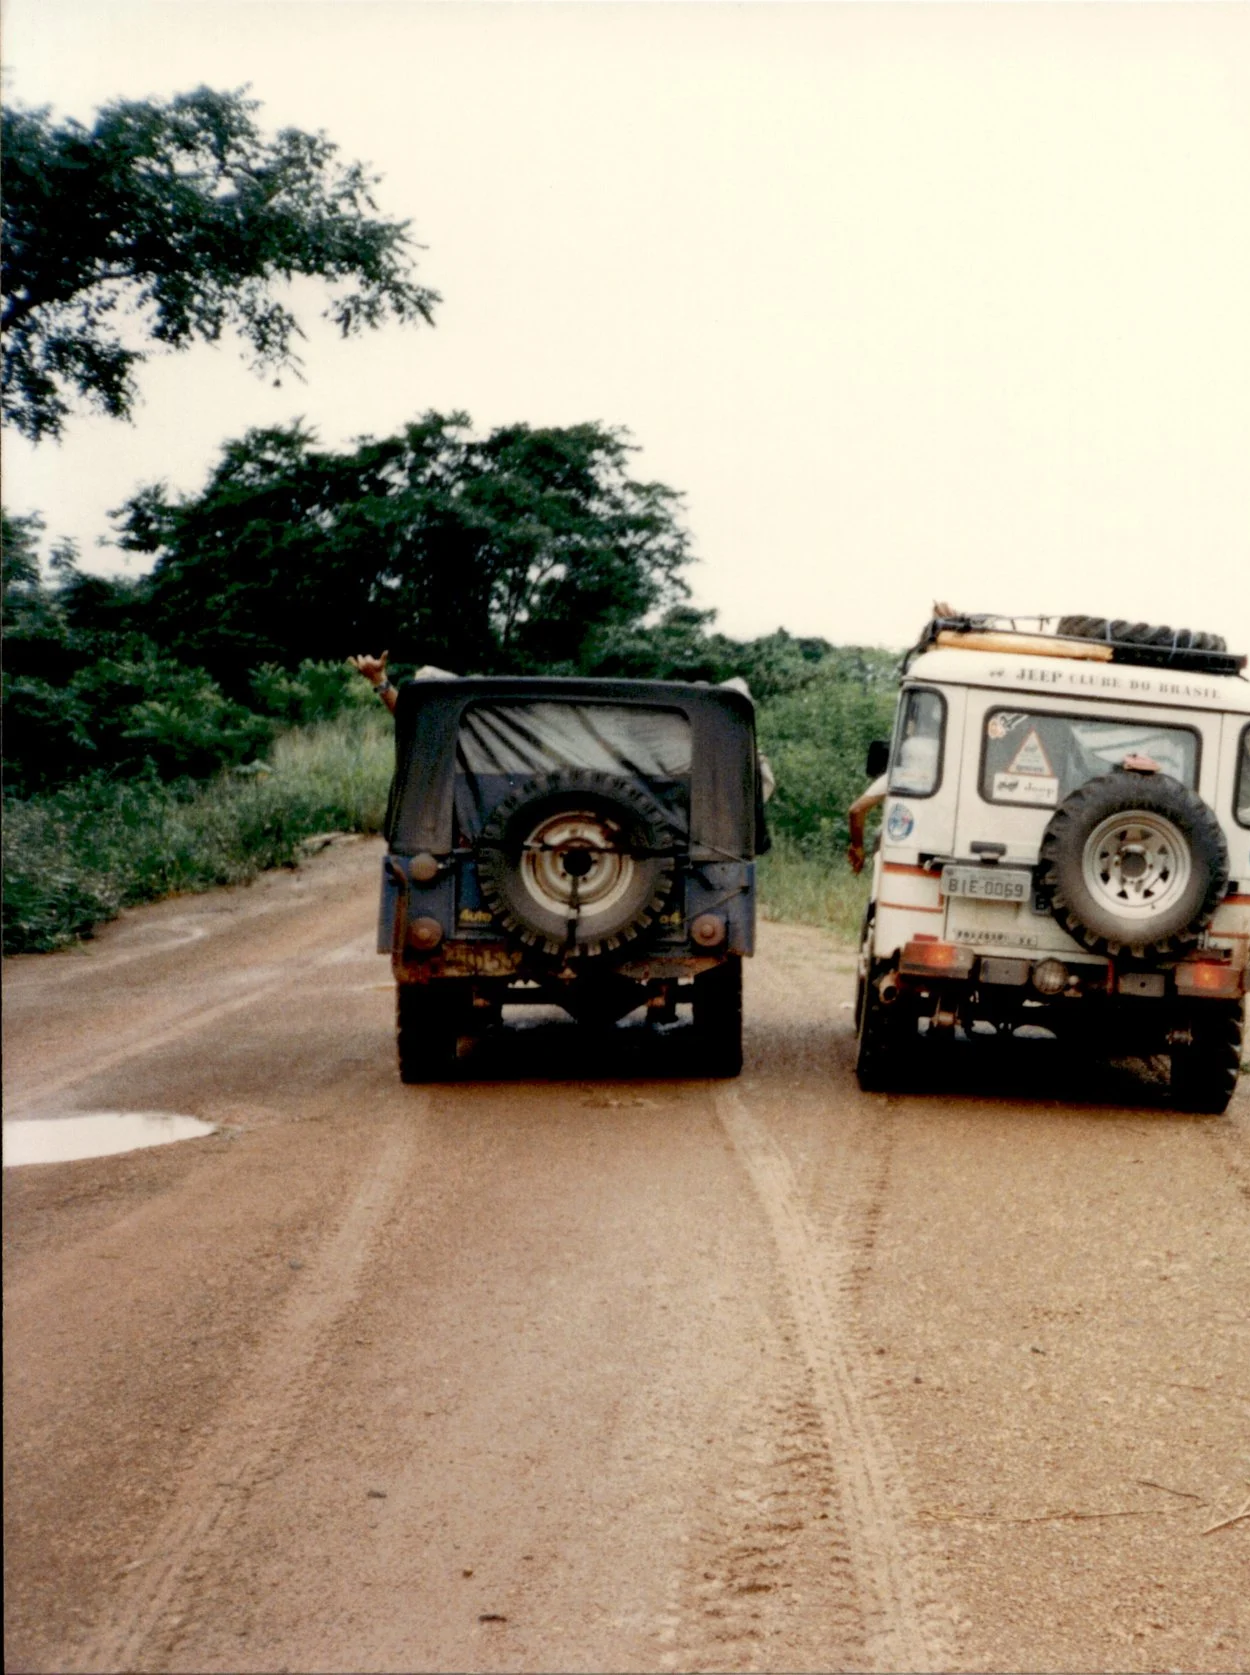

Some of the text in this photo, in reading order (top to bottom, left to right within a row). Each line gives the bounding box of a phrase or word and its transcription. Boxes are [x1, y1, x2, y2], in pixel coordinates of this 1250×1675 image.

[1016, 667, 1063, 683] JEEP
[1068, 675, 1121, 689] CLUBE
[1158, 683, 1222, 700] BRASIL
